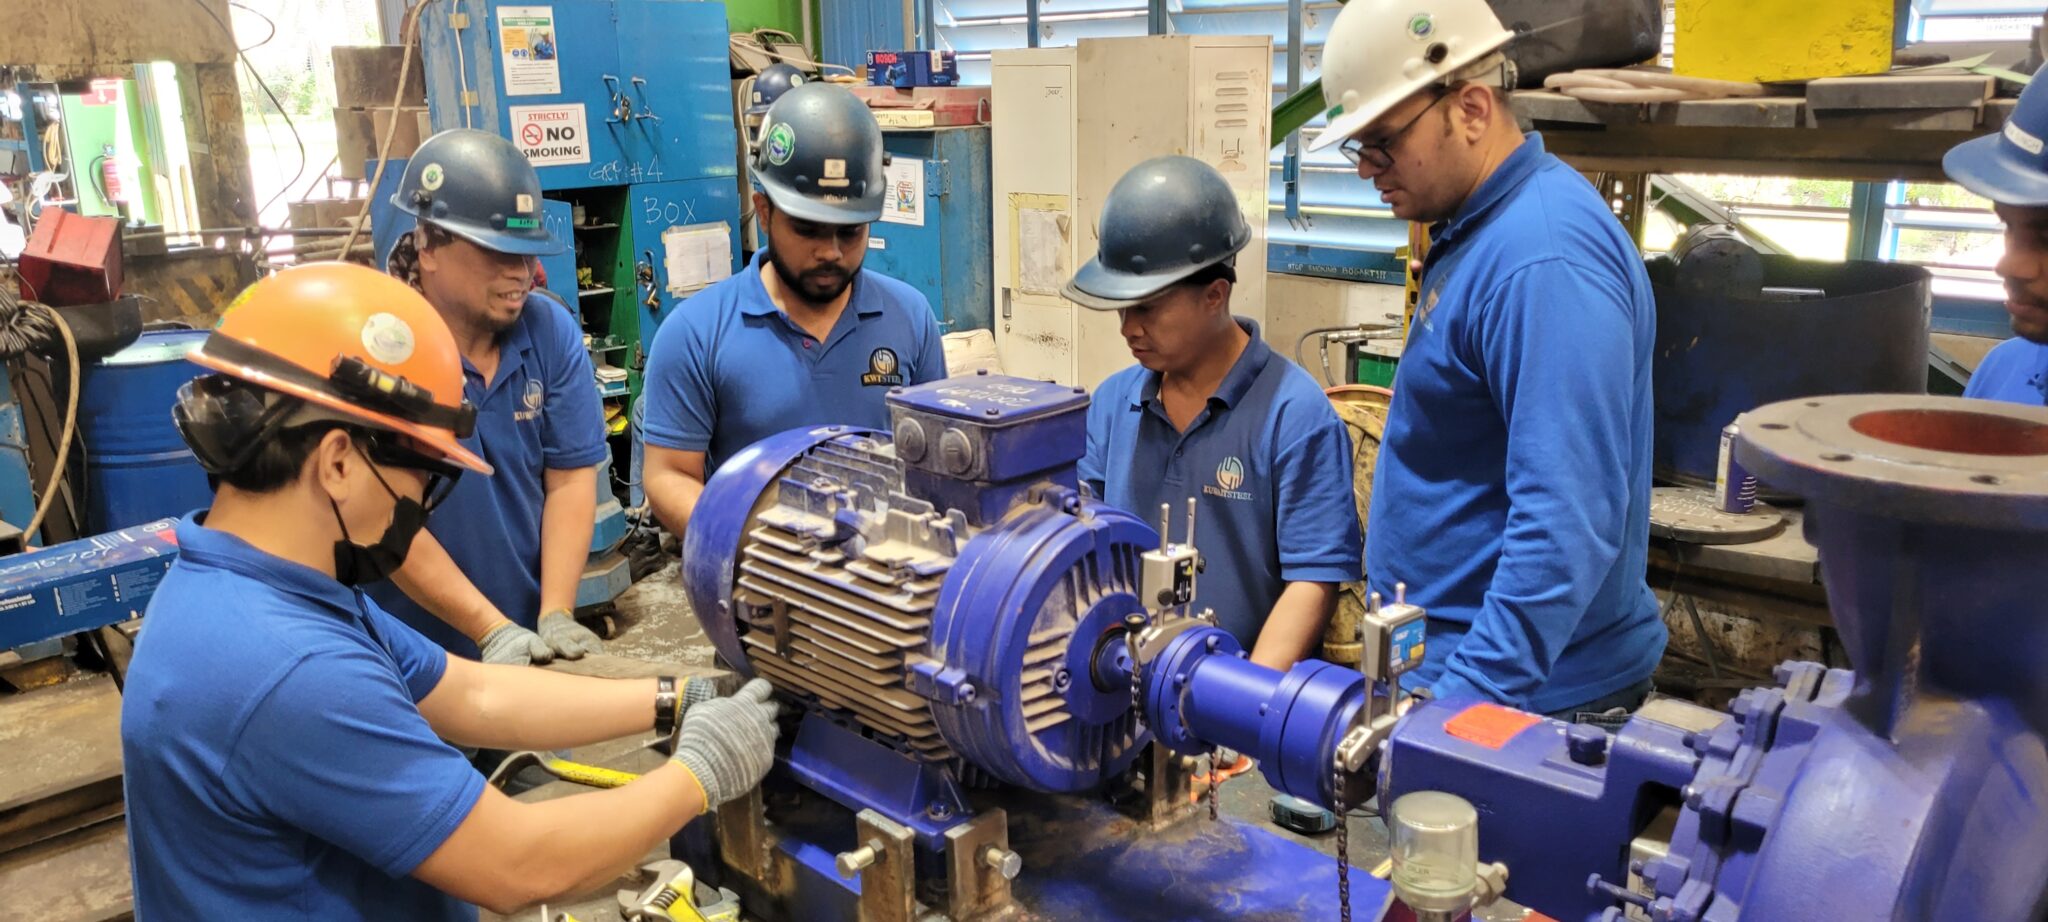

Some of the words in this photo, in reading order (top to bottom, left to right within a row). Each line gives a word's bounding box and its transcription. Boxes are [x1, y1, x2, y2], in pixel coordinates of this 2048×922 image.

[875, 53, 897, 64] BOSCH
[528, 111, 569, 121] STRICTLY!
[546, 126, 575, 142] NO
[523, 145, 581, 159] SMOKING
[644, 195, 697, 225] BOX
